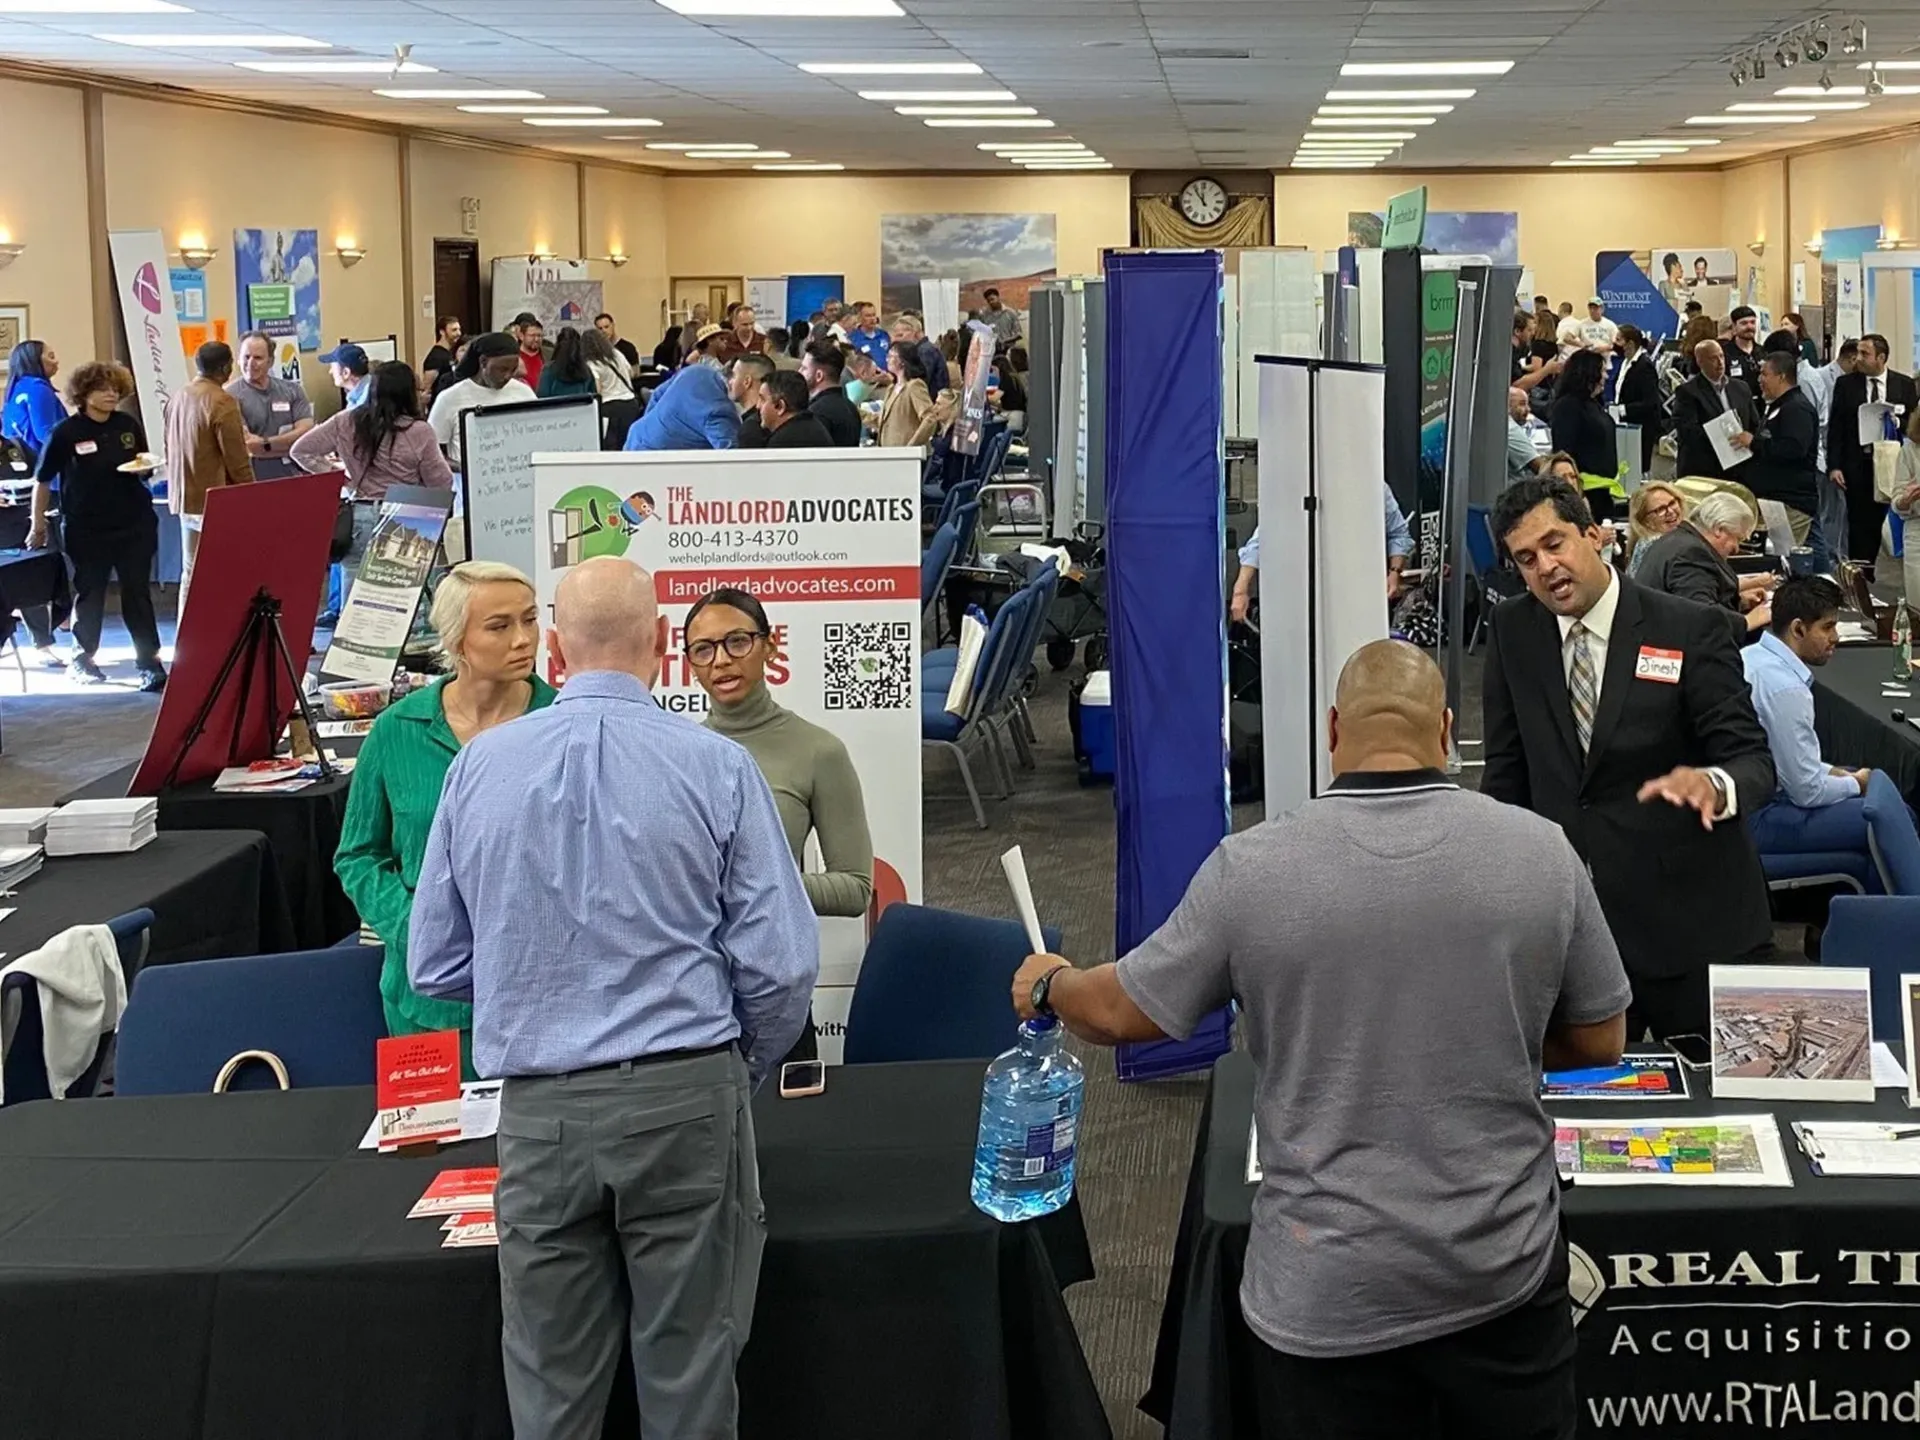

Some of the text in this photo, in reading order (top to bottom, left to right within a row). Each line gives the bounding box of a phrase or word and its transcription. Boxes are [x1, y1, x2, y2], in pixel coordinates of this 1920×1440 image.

[667, 486, 693, 502] THE
[667, 498, 914, 526] LANDLORDADVOCATES
[668, 528, 799, 549] 800-413-4370
[669, 550, 848, 565] wehelplandlords@outlook.com
[1639, 657, 1679, 676] Jinesh
[1608, 1250, 1820, 1289] REAL
[1609, 1320, 1911, 1358] Acquisitio
[1587, 1379, 1920, 1428] www.RTALand
